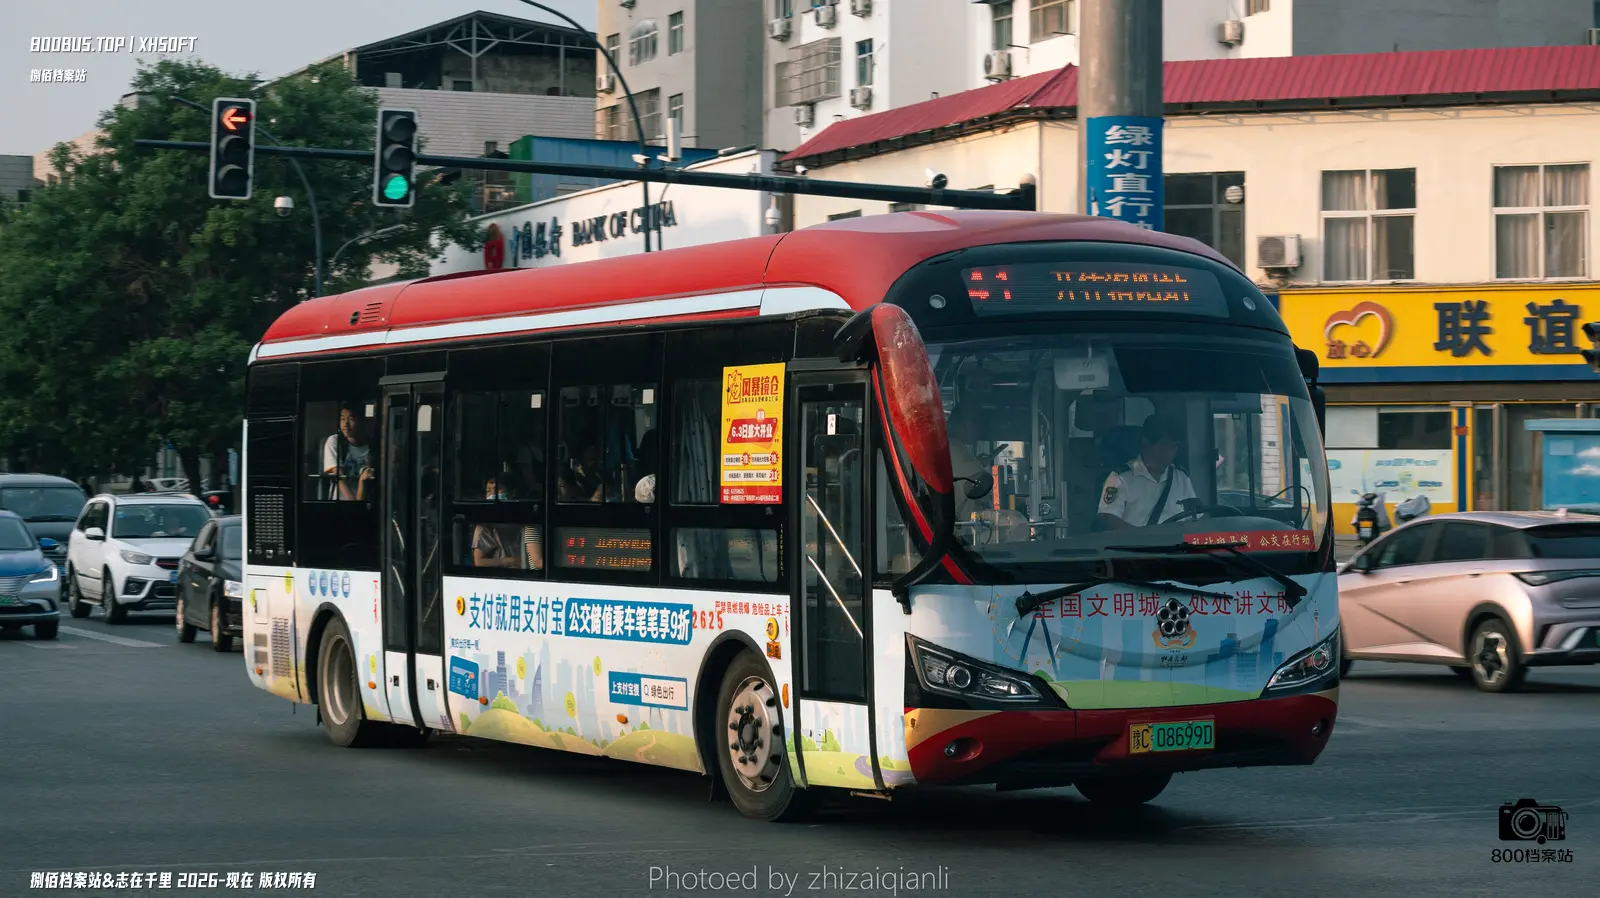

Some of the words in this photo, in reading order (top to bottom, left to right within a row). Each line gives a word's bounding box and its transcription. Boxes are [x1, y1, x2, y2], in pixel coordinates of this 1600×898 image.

[571, 215, 608, 247] BANK
[610, 210, 628, 239] OF
[1433, 299, 1580, 356] 联谊
[742, 375, 779, 396] 风暴镜仓
[1260, 533, 1311, 547] 公交在行动
[469, 592, 563, 635] 支付就用支付宝
[569, 602, 690, 641] 公交储值乘车笔笔享9折
[692, 609, 724, 630] 2625
[752, 602, 782, 616] 危险品上车
[651, 684, 675, 700] 绿色出行
